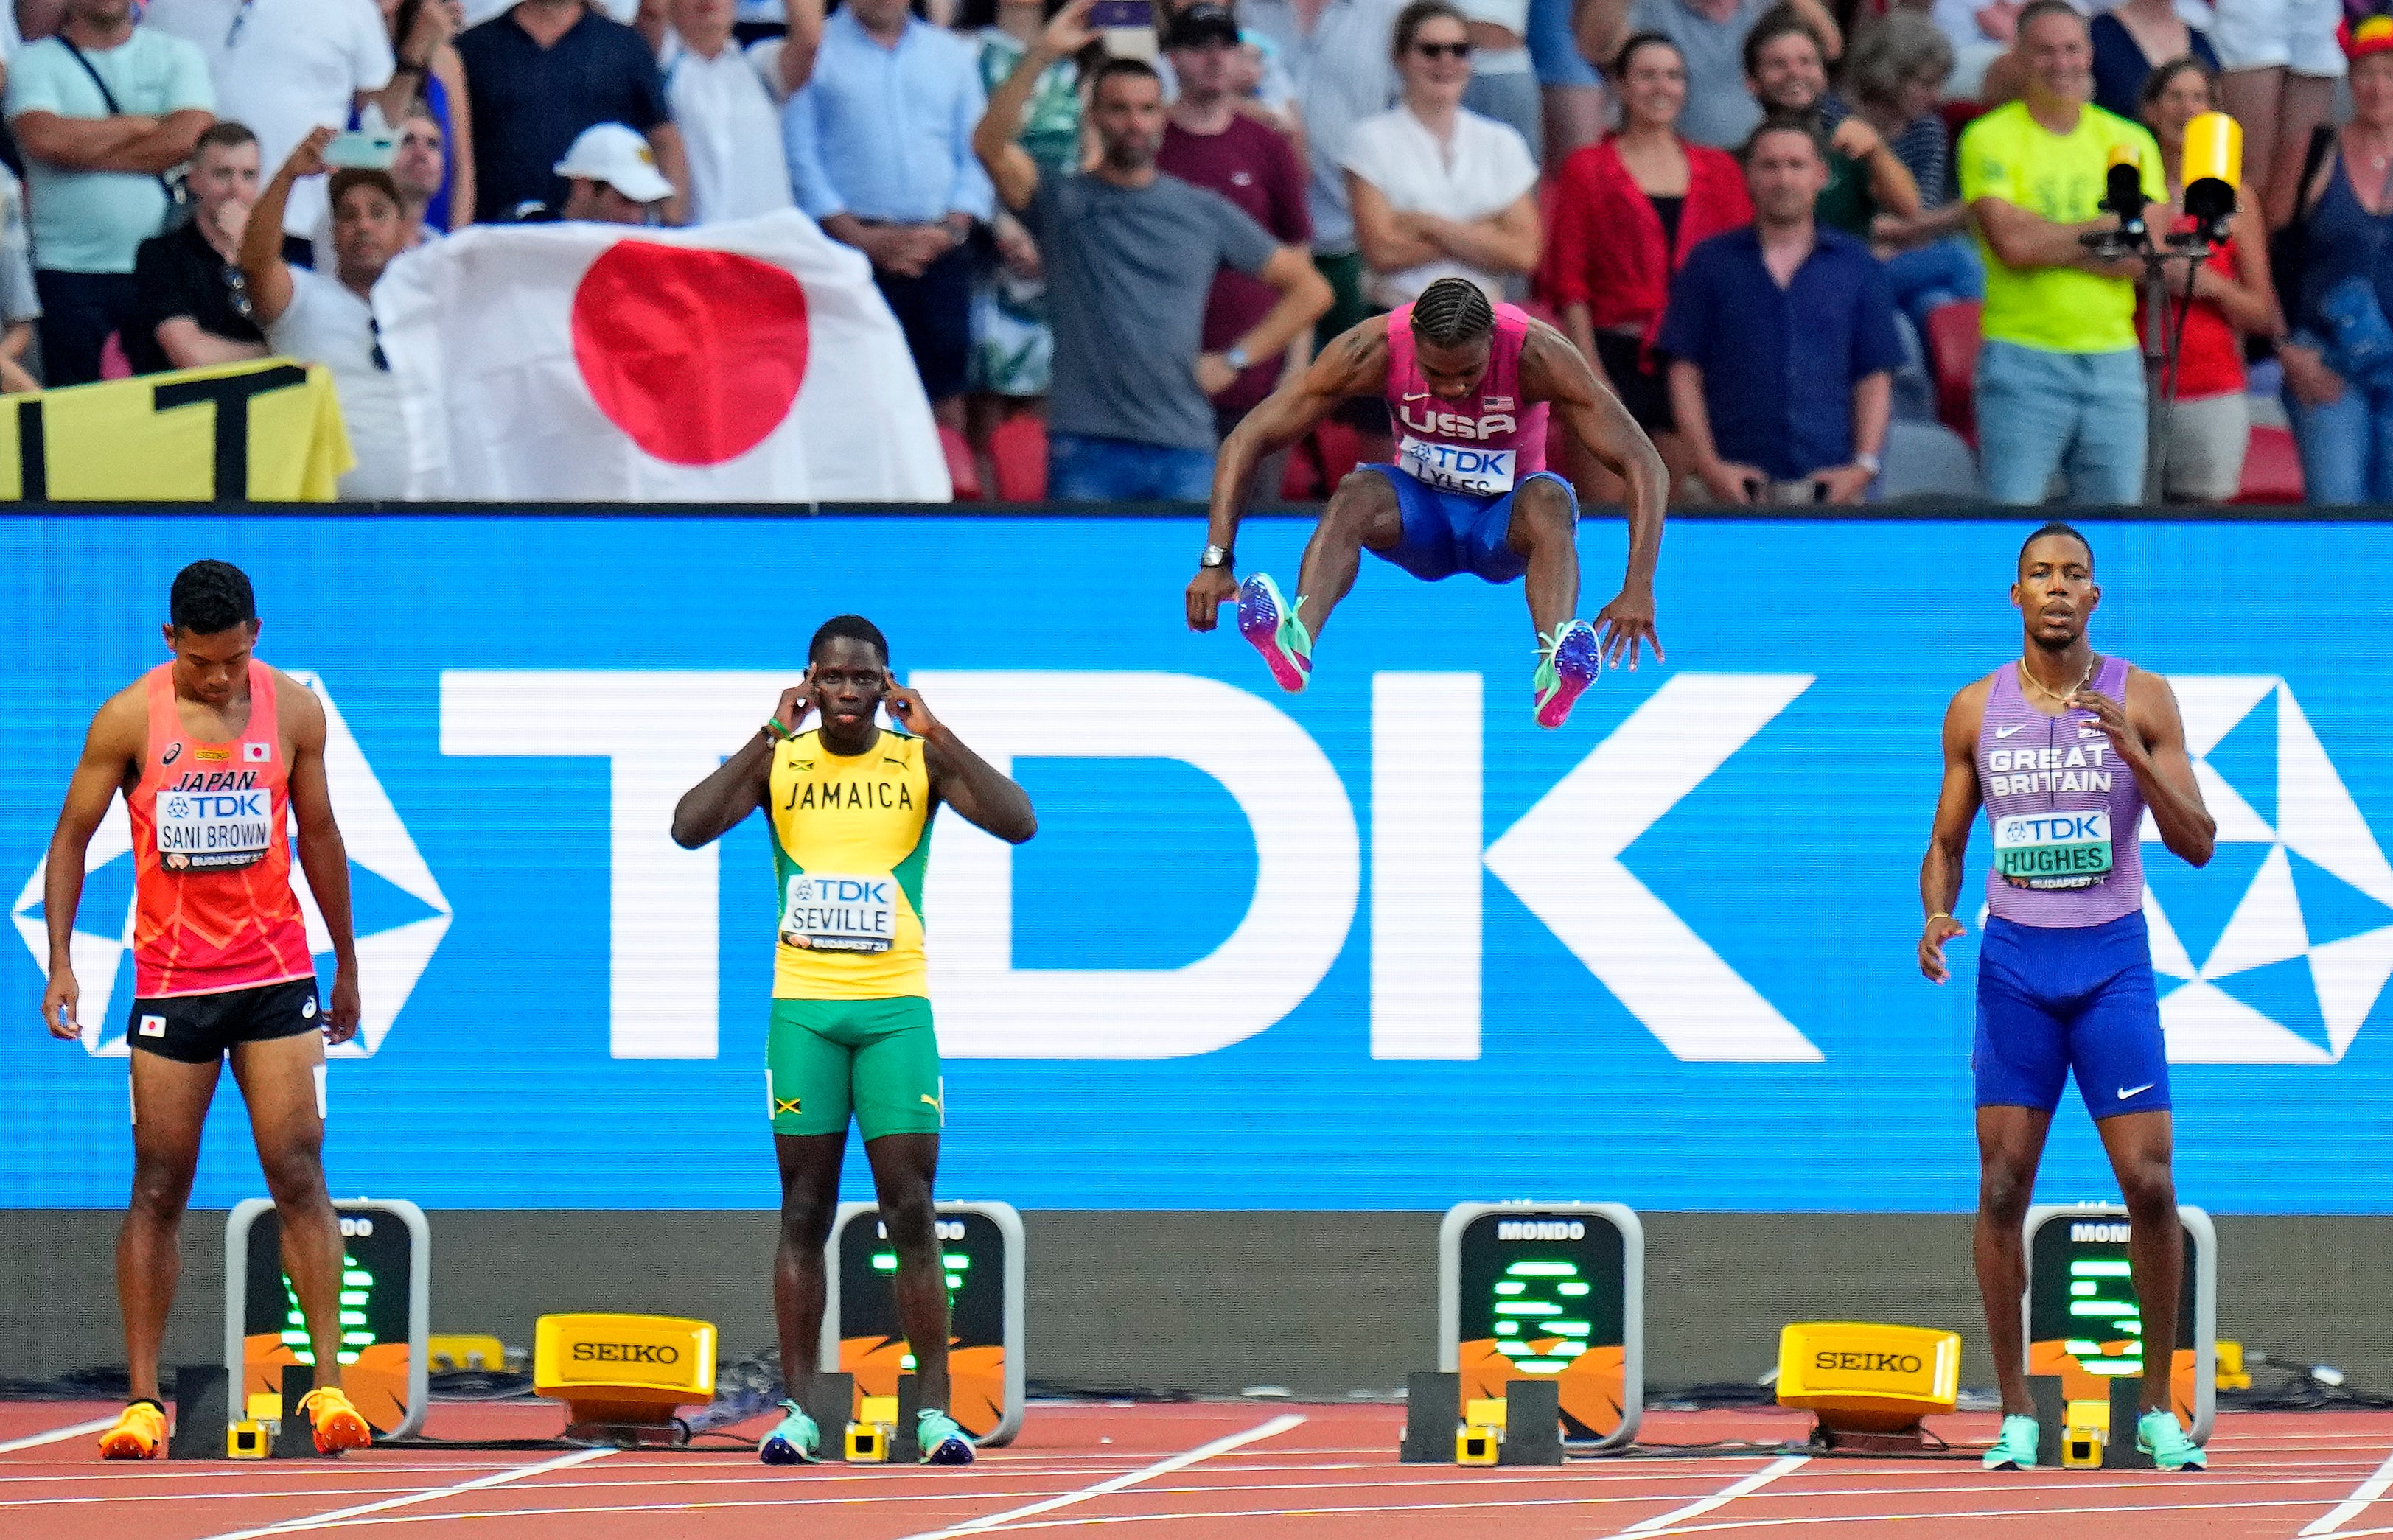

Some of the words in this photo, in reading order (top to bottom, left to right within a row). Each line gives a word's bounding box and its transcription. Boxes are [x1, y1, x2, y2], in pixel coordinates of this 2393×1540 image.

[1400, 405, 1517, 441] USA
[1434, 446, 1506, 475] TDK
[1990, 743, 2110, 771] GREAT
[173, 771, 258, 792] JAPAN
[1992, 771, 2112, 797] BRITAIN
[190, 794, 262, 819] TDK
[785, 782, 913, 811] JAMAICA
[163, 825, 200, 848] SANI
[207, 822, 266, 847] BROWN
[2027, 816, 2100, 840] TDK
[439, 671, 1828, 1063] TDK
[2003, 847, 2104, 873] HUGHES
[814, 879, 889, 904] TDK
[793, 907, 887, 932] SEVILLE
[1497, 1222, 1585, 1241] MONDO
[2070, 1223, 2132, 1242] MON
[1495, 1261, 1592, 1373] 6
[2064, 1261, 2144, 1375] 5
[573, 1342, 679, 1364] SEIKO
[1816, 1351, 1922, 1373] SEIKO
